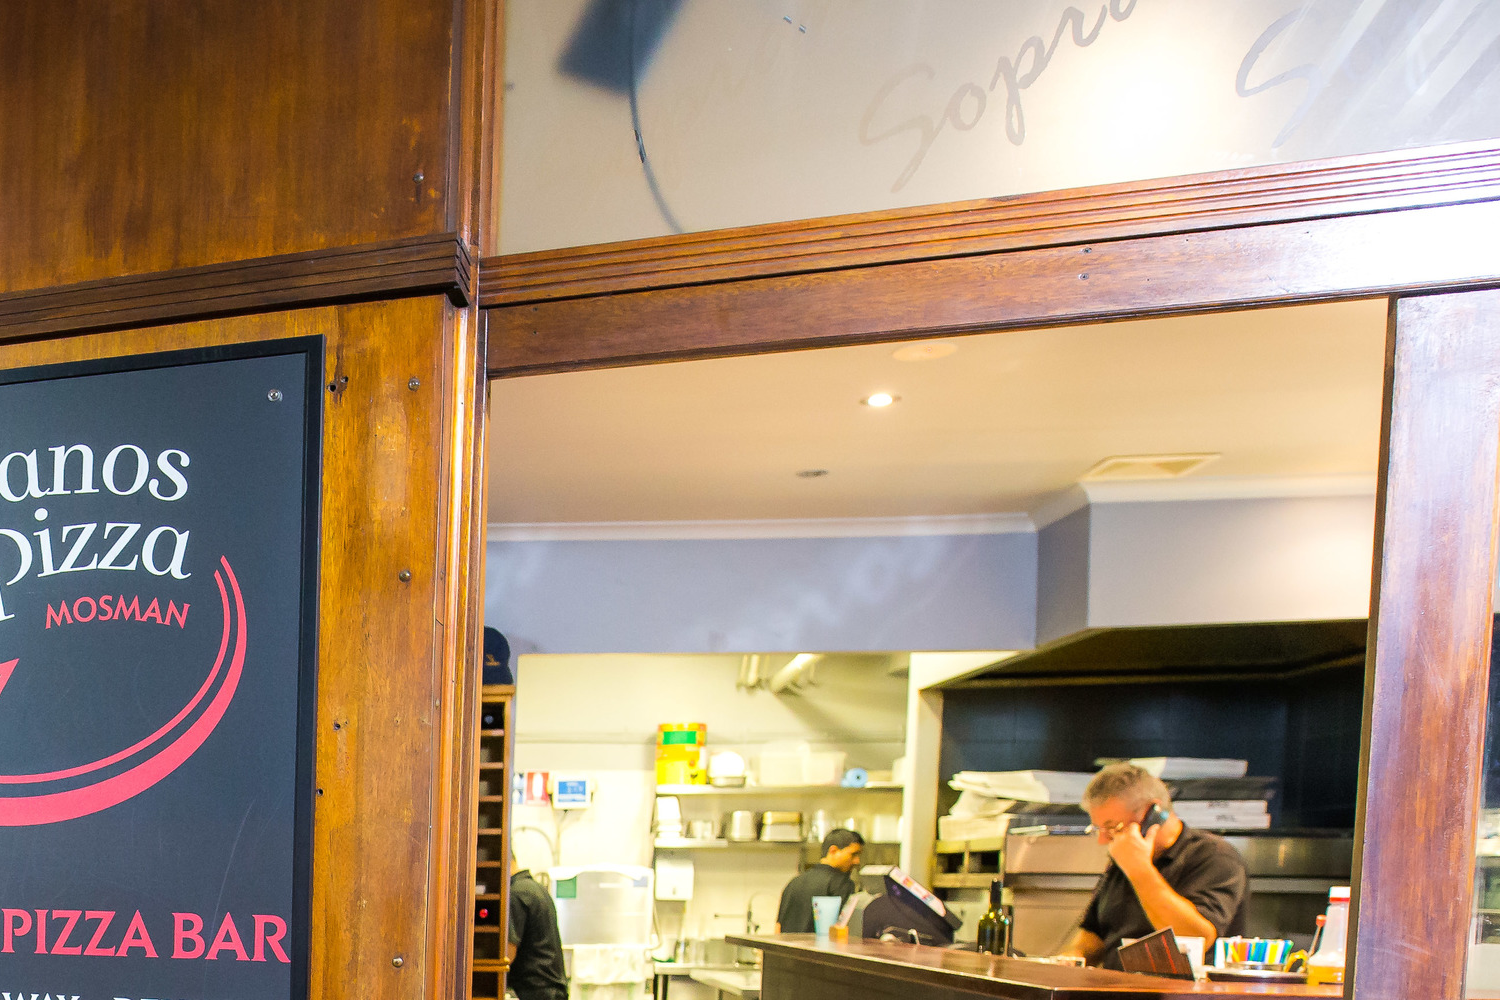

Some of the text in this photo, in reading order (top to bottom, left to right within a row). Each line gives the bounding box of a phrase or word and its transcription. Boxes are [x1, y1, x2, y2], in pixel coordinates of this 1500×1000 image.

[45, 595, 191, 630] MOSMAN
[0, 908, 158, 958] PIZZA
[171, 912, 291, 963] BAR
